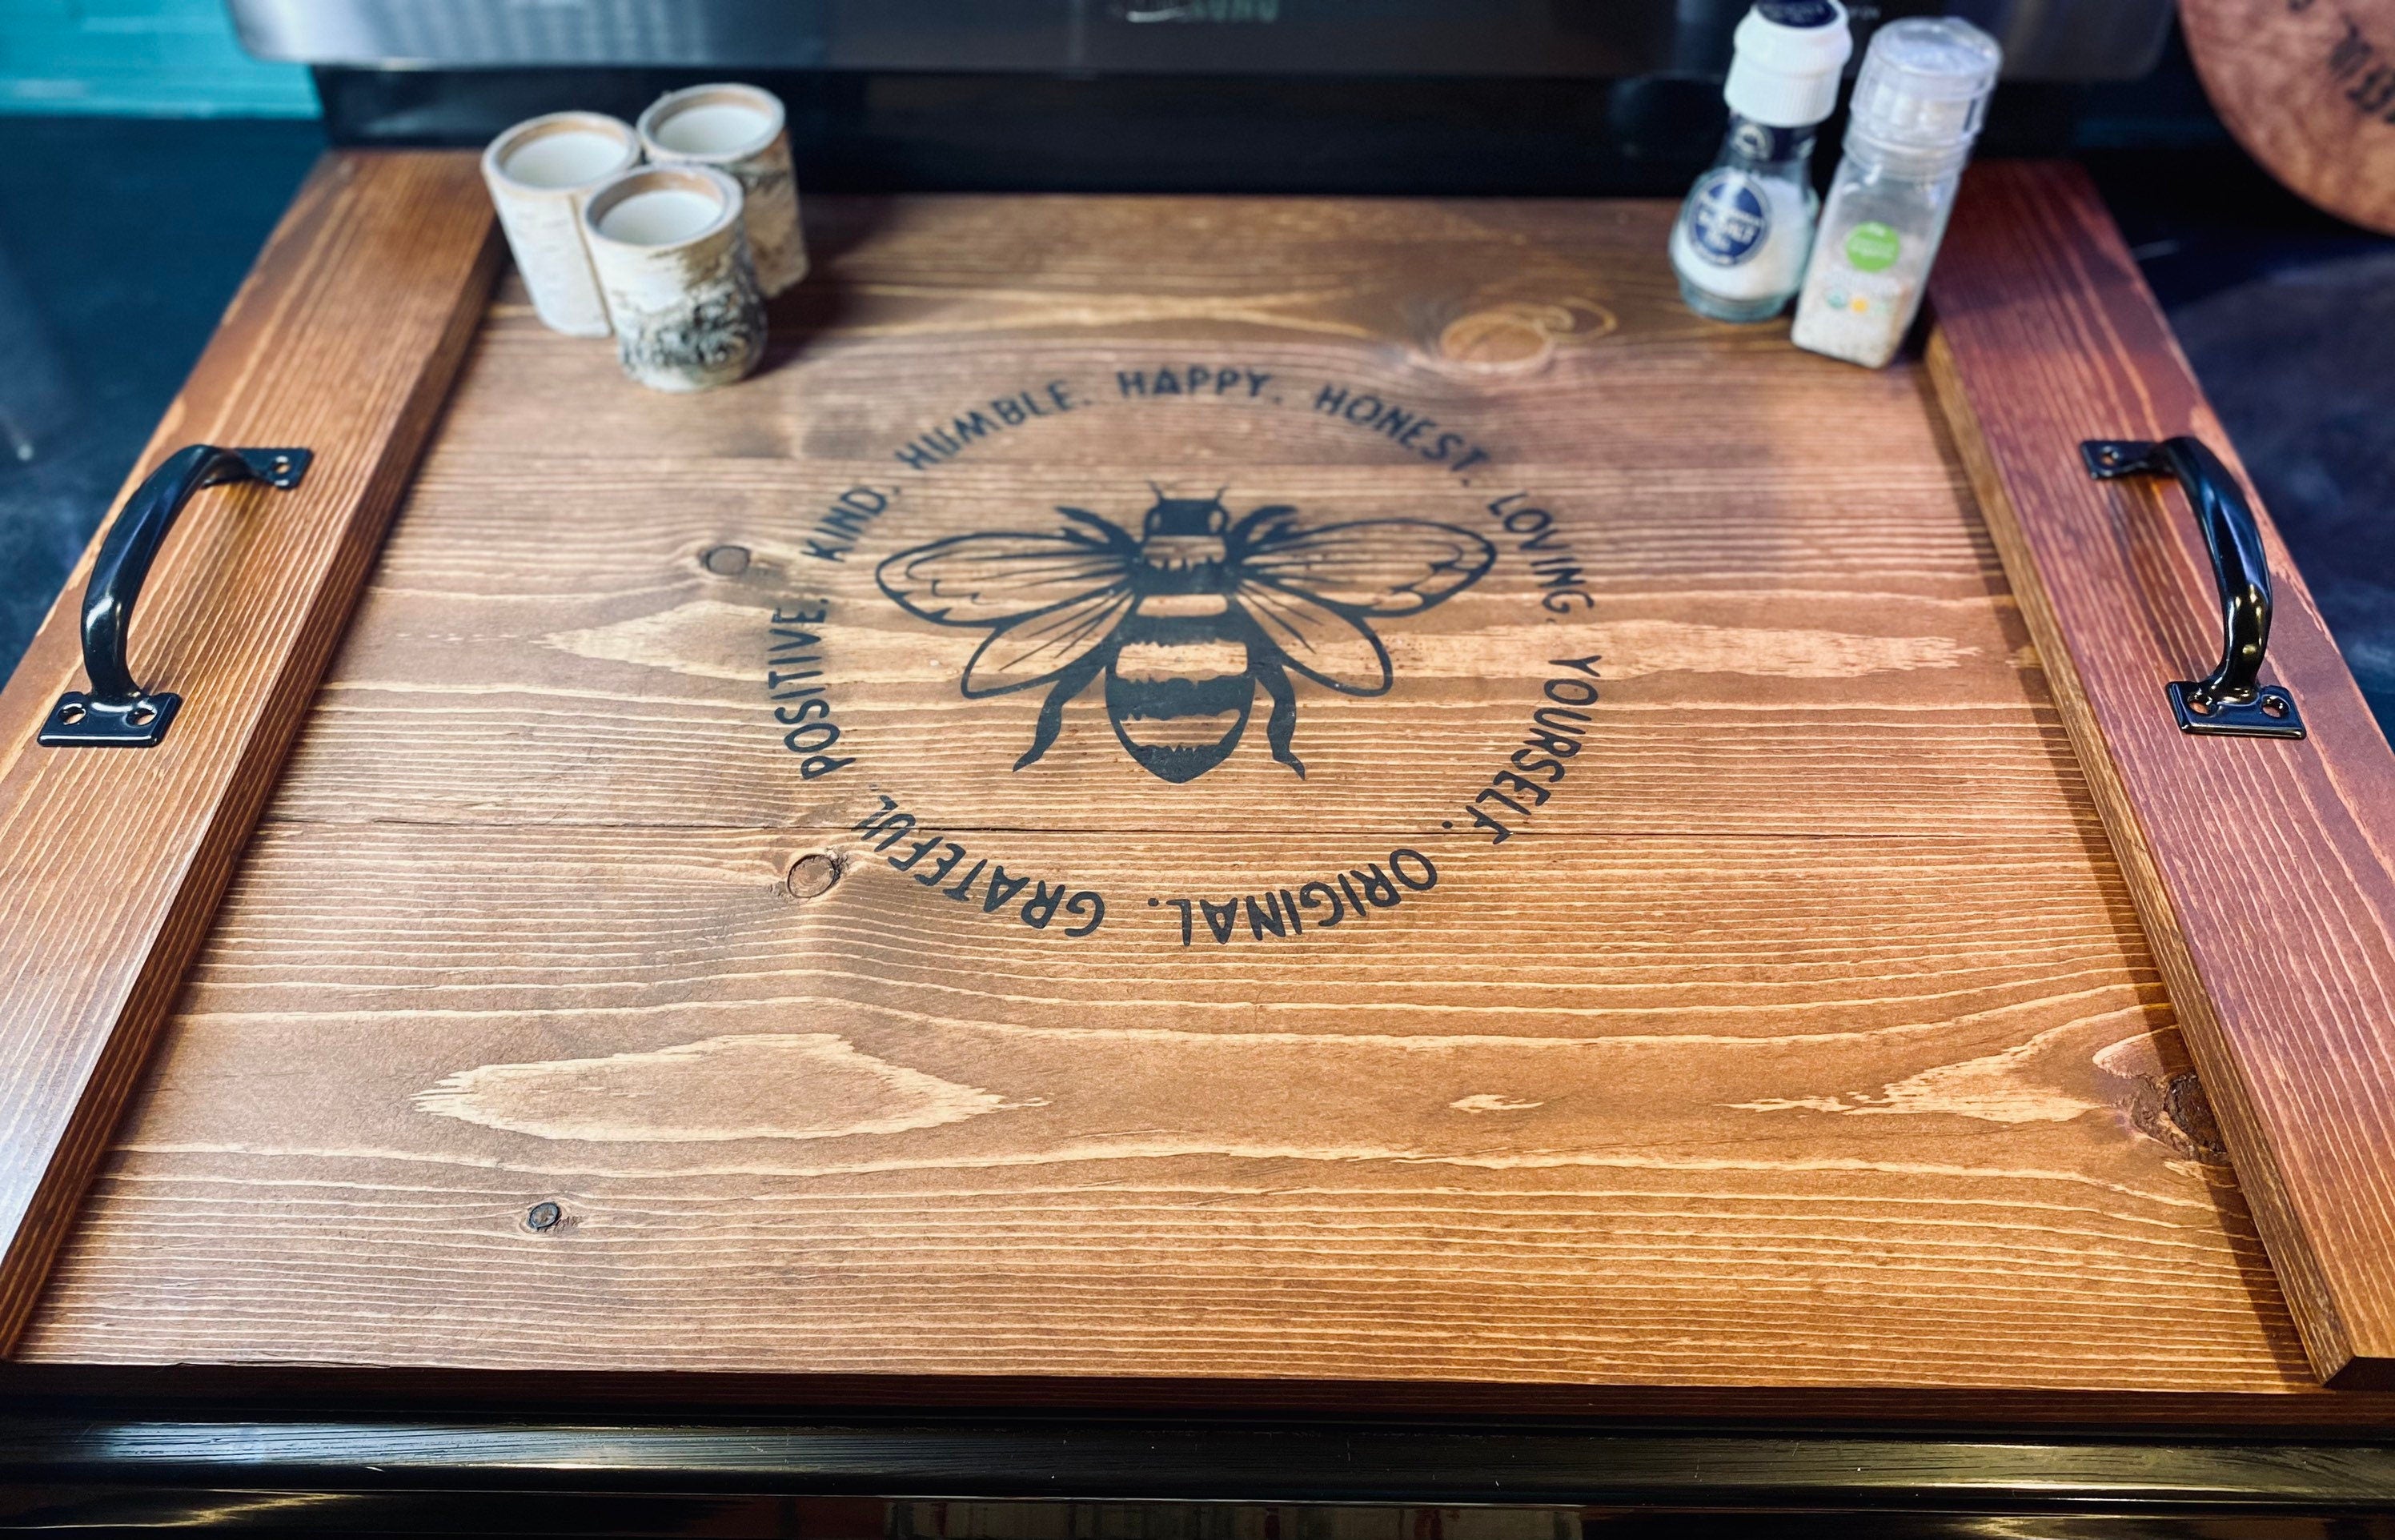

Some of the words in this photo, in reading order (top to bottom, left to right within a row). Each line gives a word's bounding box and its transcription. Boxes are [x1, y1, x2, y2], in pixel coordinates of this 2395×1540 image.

[896, 381, 1091, 470] HUMBLE.
[1117, 367, 1281, 403] HAPPY.
[1314, 385, 1488, 487] HONEST.
[1487, 491, 1595, 622] LOVING.
[768, 599, 857, 780] POSITIVE.
[1442, 655, 1602, 844] YOURSELF.
[1148, 848, 1438, 946] ORIGINAL.
